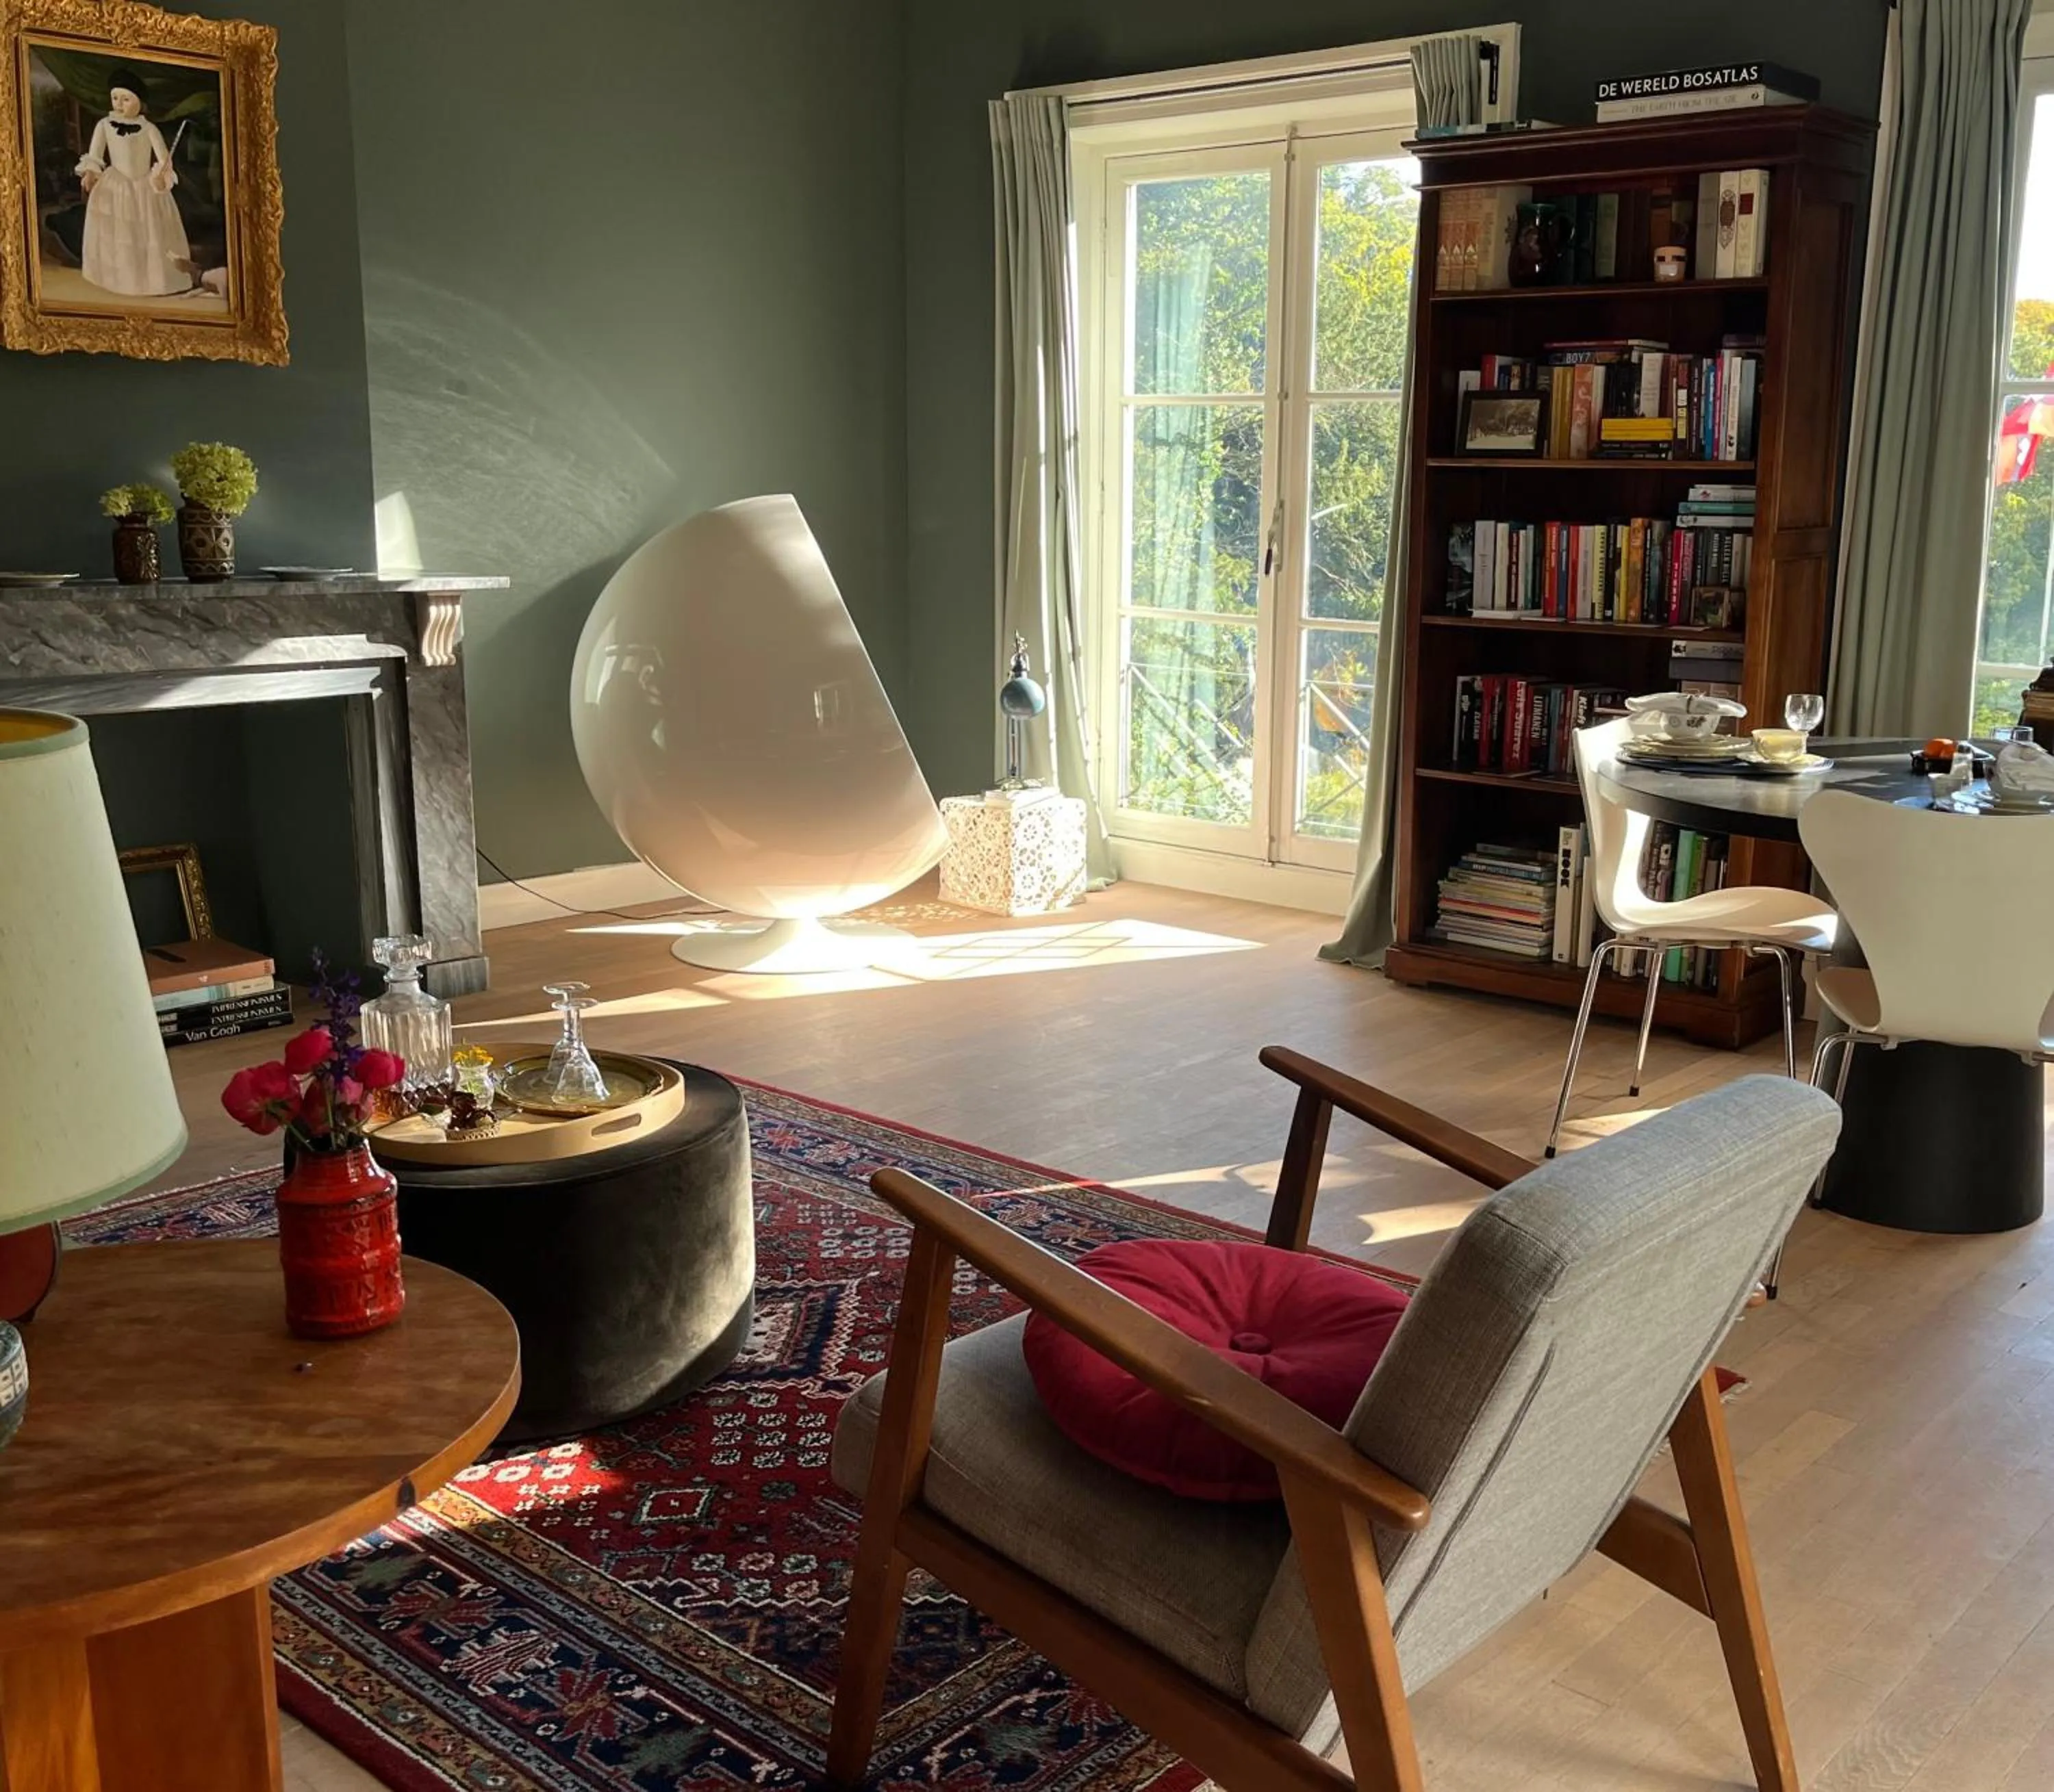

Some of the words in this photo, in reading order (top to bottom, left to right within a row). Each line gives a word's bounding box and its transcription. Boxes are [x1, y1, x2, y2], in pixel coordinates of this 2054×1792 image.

[1599, 84, 1617, 97] DE
[1621, 75, 1679, 94] WERELD
[1683, 66, 1758, 88] BOSATLAS
[186, 1030, 207, 1042] Van
[210, 1023, 241, 1038] Gogh
